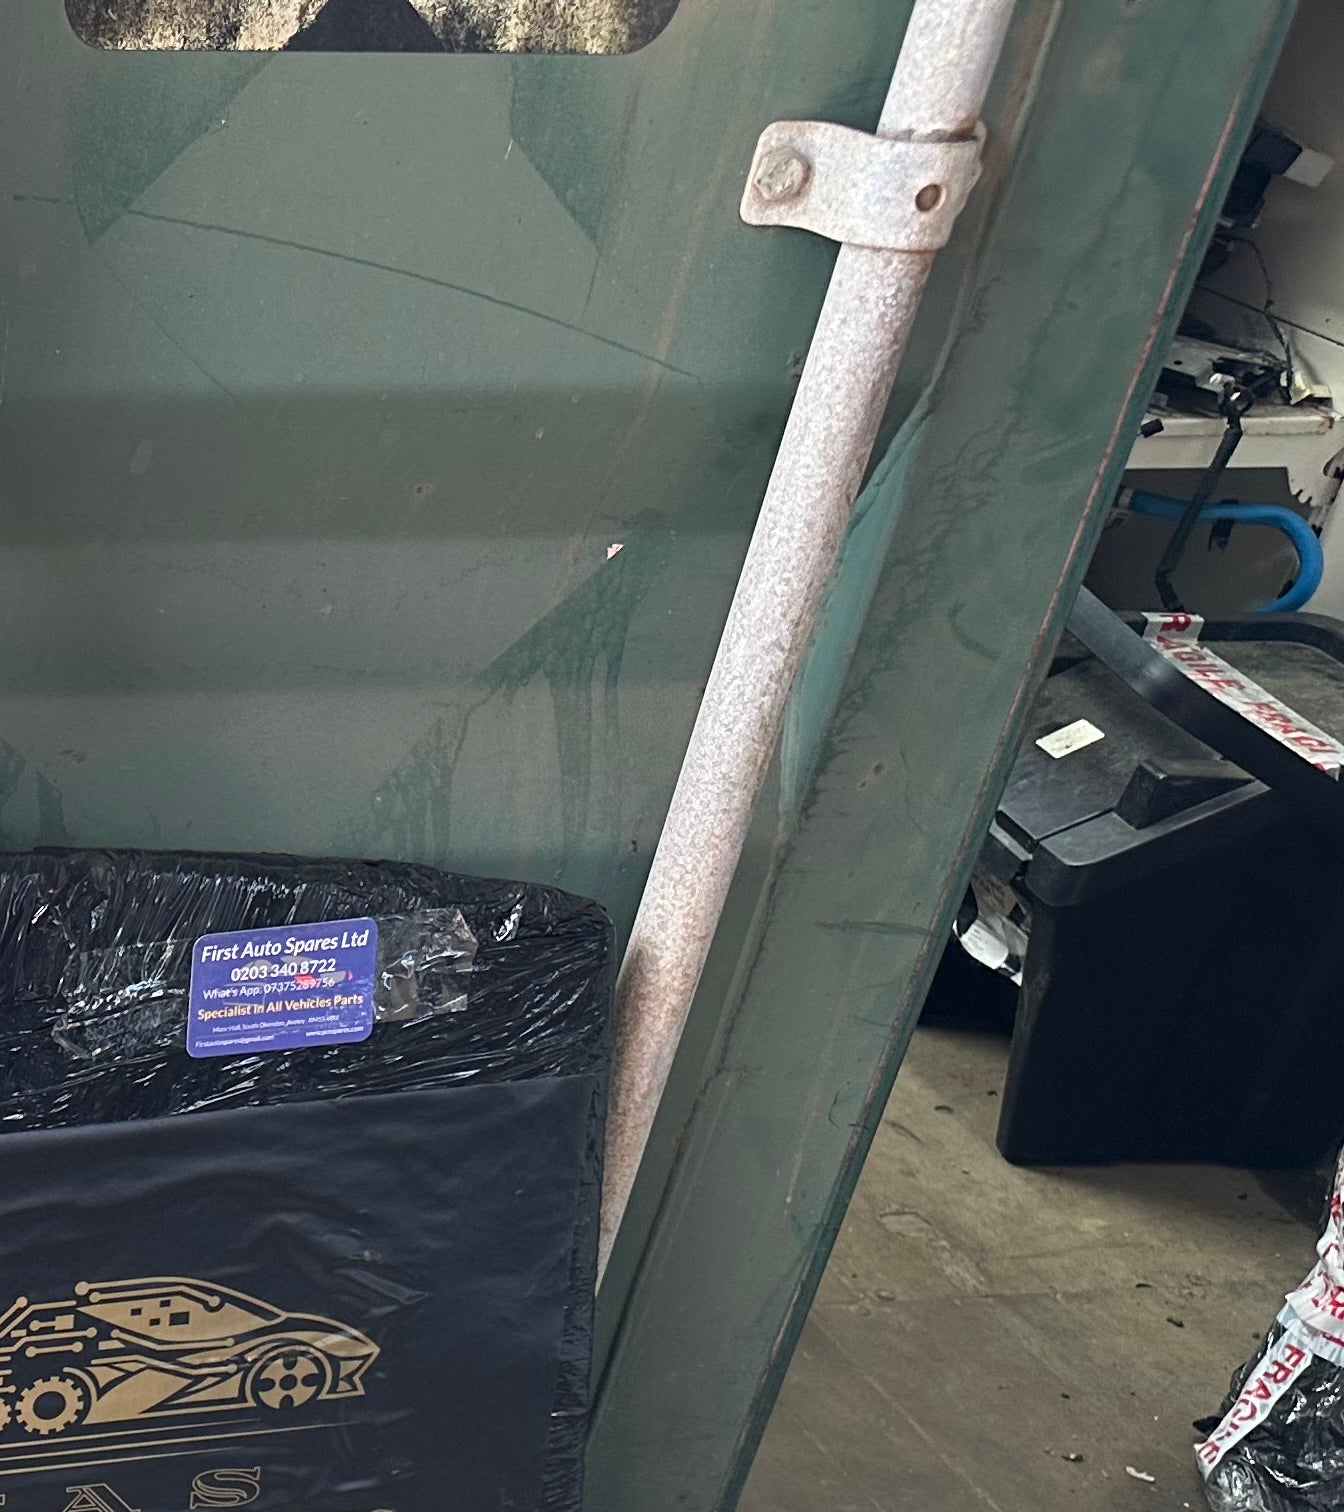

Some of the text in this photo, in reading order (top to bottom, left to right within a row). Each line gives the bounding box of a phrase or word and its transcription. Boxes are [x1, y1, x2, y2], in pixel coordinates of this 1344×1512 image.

[1157, 613, 1246, 692] RAGILE
[200, 929, 369, 963] First Auto Spares Ltd
[230, 958, 337, 983] 0203 340 8722
[197, 1005, 252, 1022] Specialist
[266, 1000, 283, 1013] All
[285, 996, 332, 1012] Vehicles
[333, 993, 364, 1007] Parts
[202, 987, 239, 1001] What's
